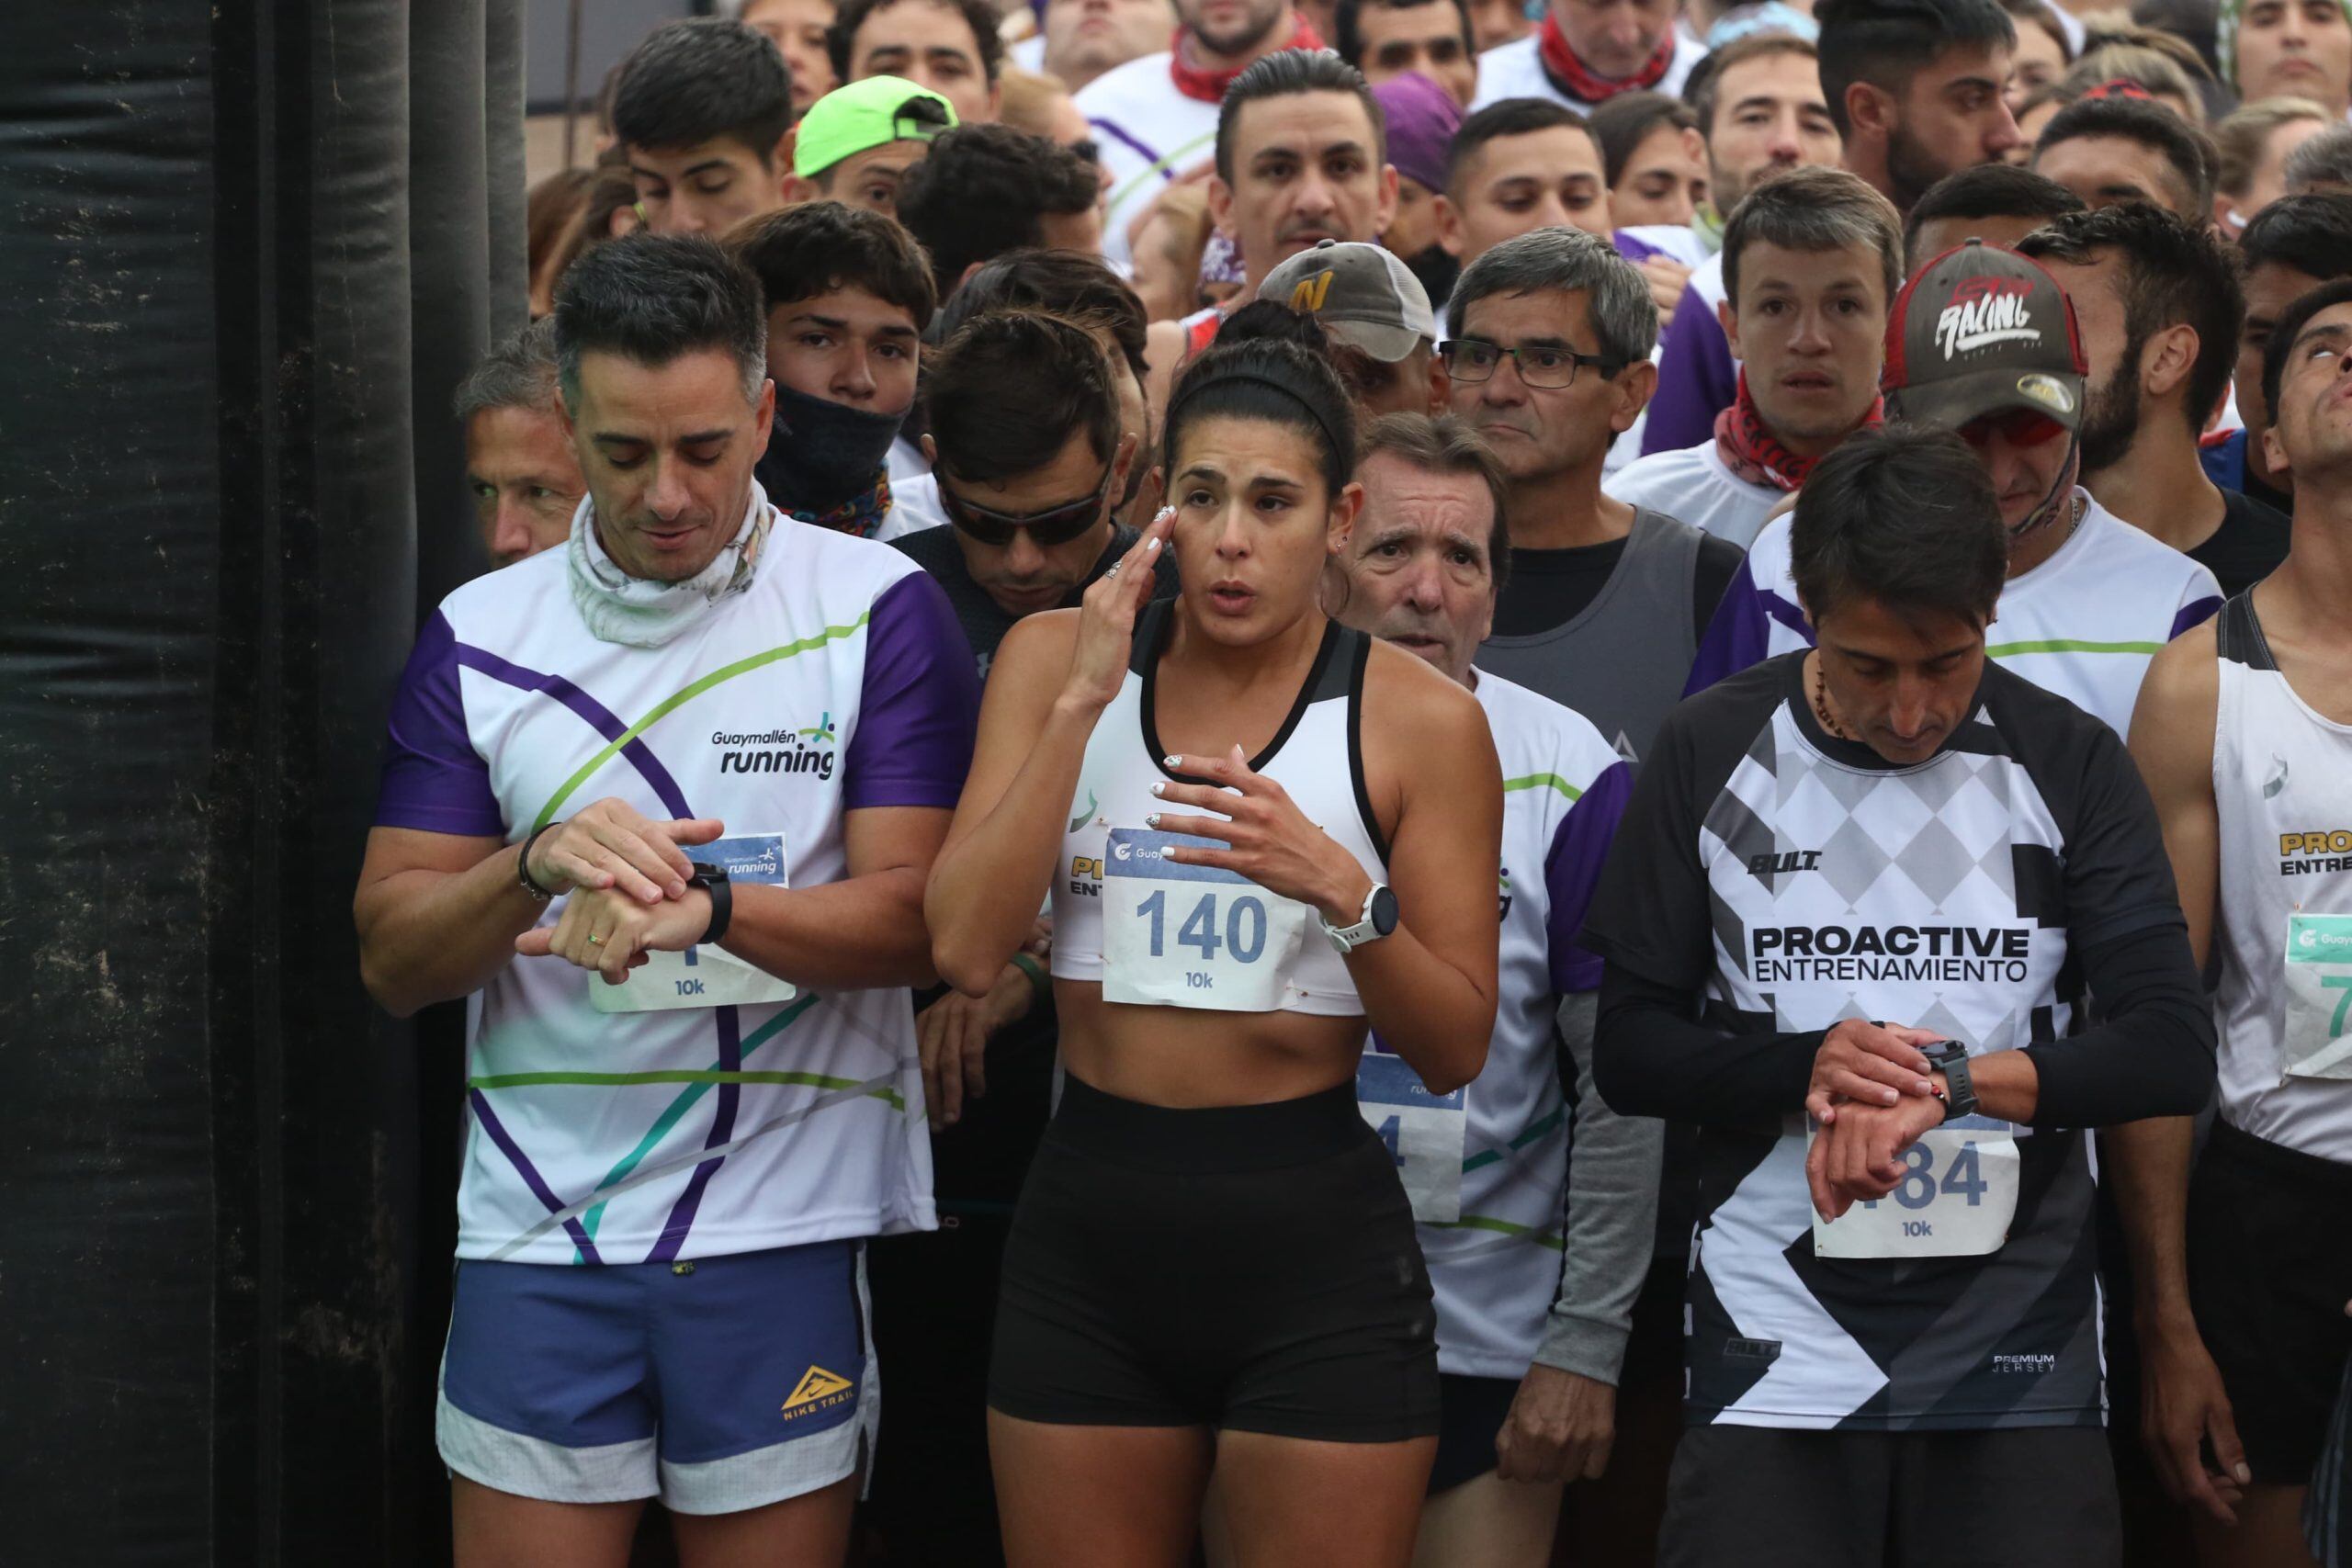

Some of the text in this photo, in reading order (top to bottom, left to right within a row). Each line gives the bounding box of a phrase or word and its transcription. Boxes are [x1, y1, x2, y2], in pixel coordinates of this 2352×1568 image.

[1935, 292, 2031, 361] RACING
[712, 730, 796, 747] Guaymallén
[721, 743, 833, 780] running
[2279, 830, 2352, 856] PRO
[729, 861, 776, 874] running
[2280, 856, 2352, 875] ENTRE
[1136, 890, 1267, 964] 140
[1752, 925, 2030, 957] PROACTIVE
[2321, 933, 2352, 947] Guay
[1185, 972, 1213, 988] 10k
[1755, 958, 2028, 983] ENTRENAMIENTO
[675, 978, 705, 995] 10k
[1864, 1140, 1987, 1210] 84
[1902, 1220, 1932, 1237] 10k
[1992, 1362, 2054, 1372] JERSEY
[1994, 1355, 2054, 1363] PREMIUM
[784, 1390, 854, 1421] NIKE TRAIL
